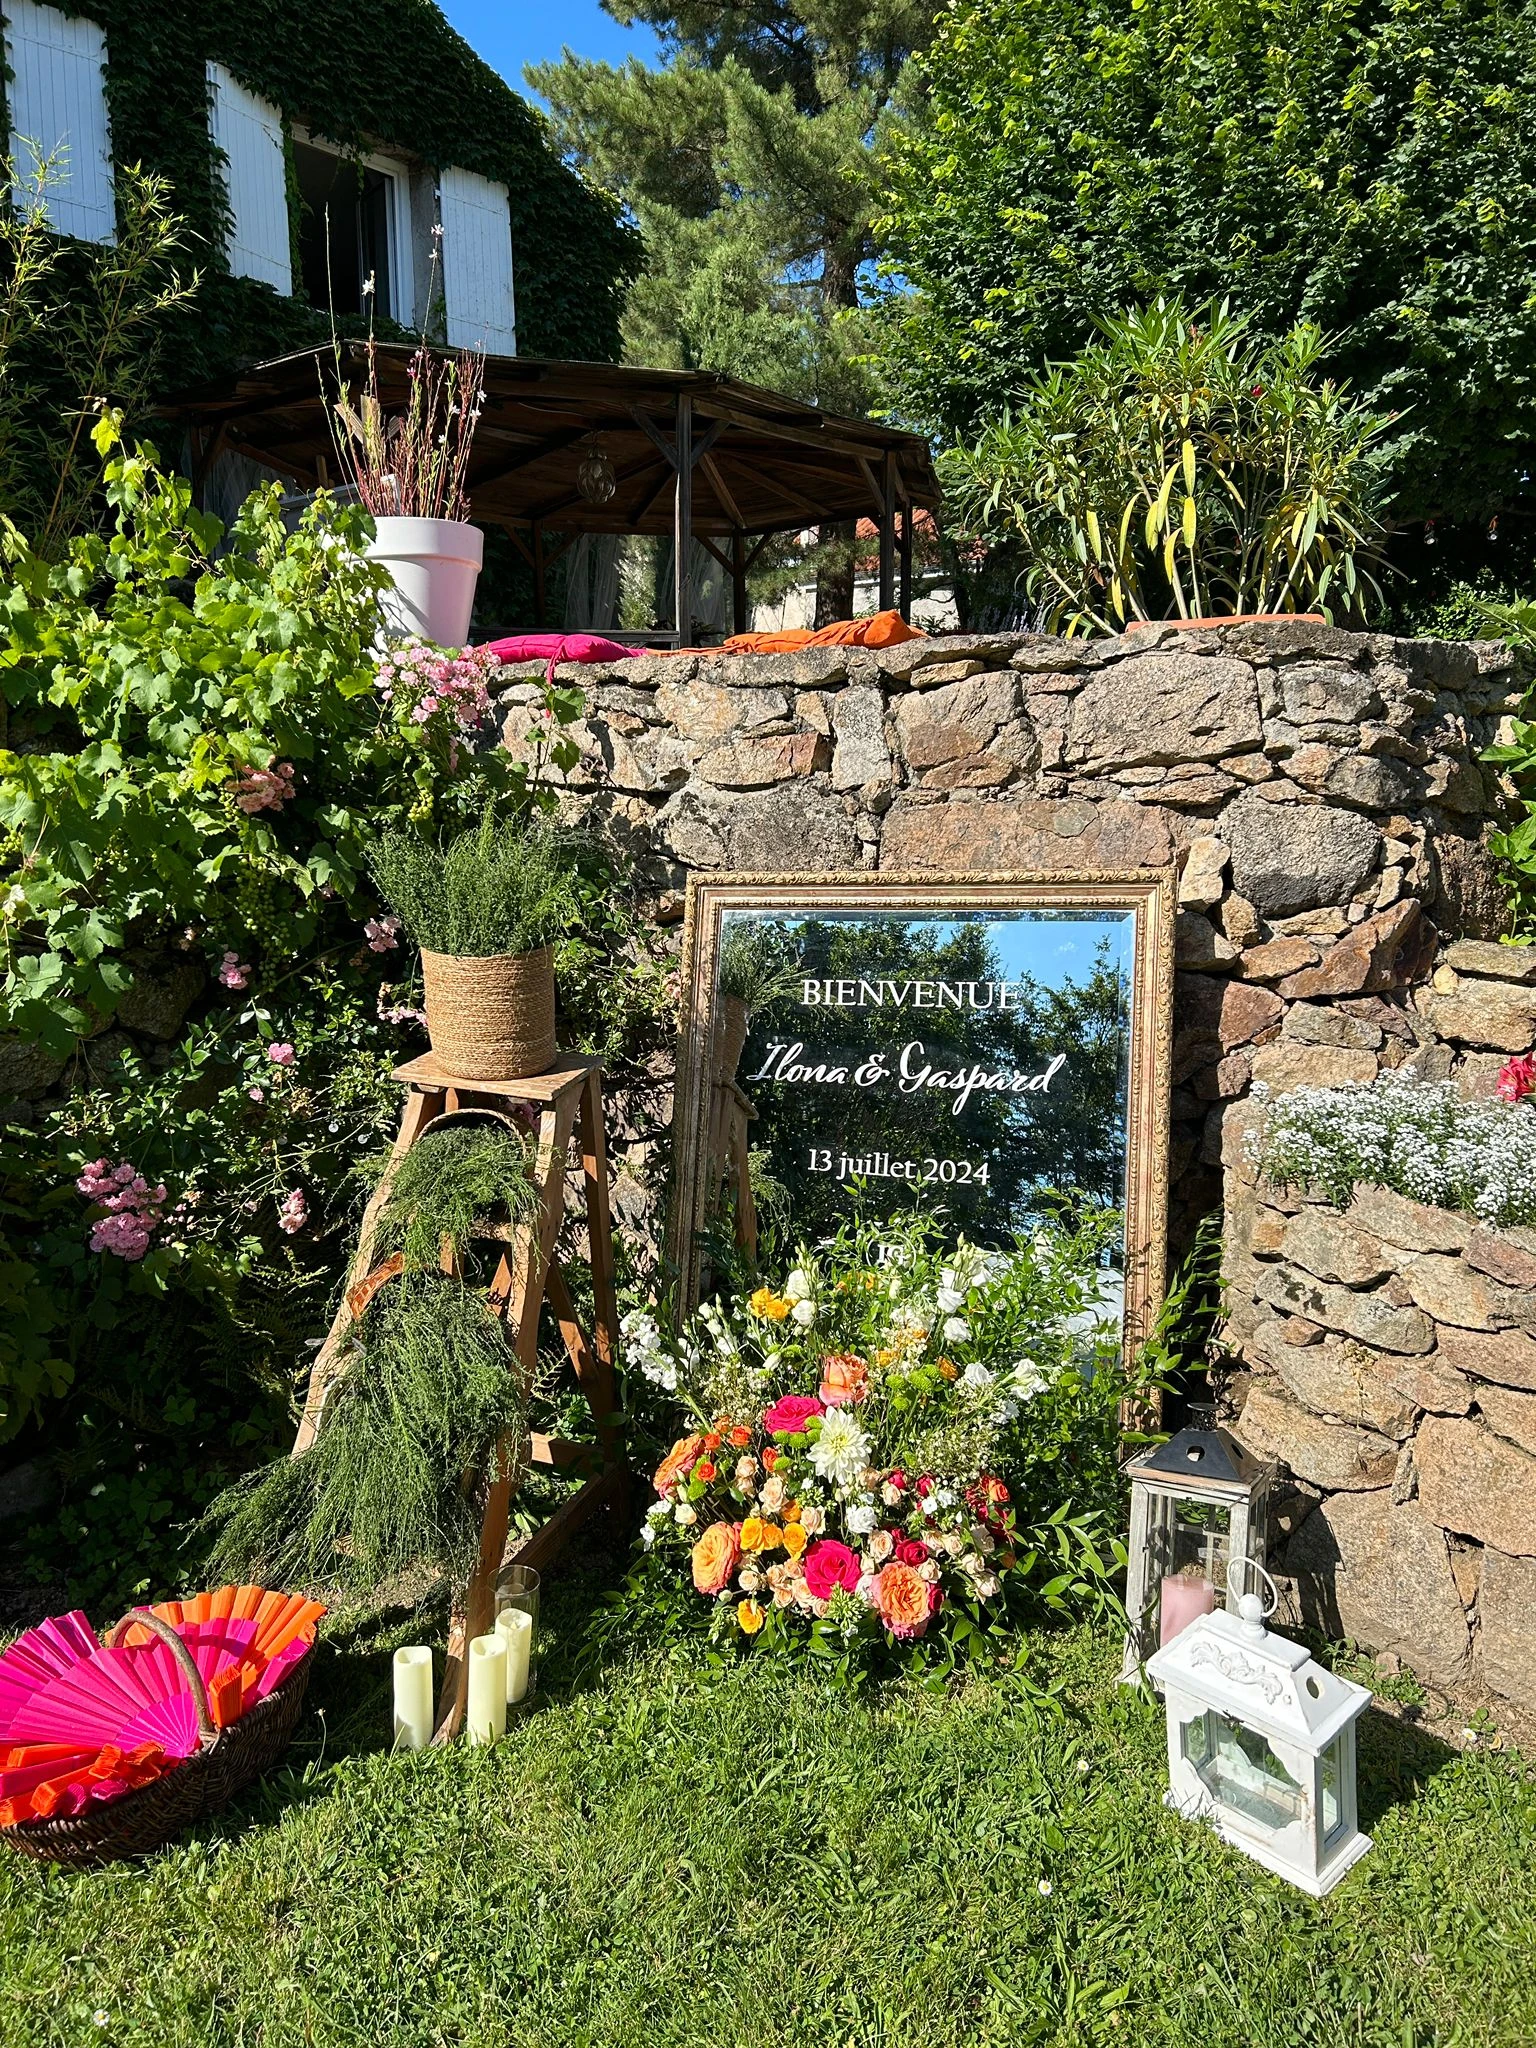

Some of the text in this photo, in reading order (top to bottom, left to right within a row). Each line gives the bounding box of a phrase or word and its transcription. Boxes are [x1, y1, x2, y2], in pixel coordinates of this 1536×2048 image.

[800, 979, 1023, 1010] BIENVENUE
[746, 1041, 1067, 1116] Ilona & Gaspard
[807, 1149, 991, 1186] 13 juillet 2024
